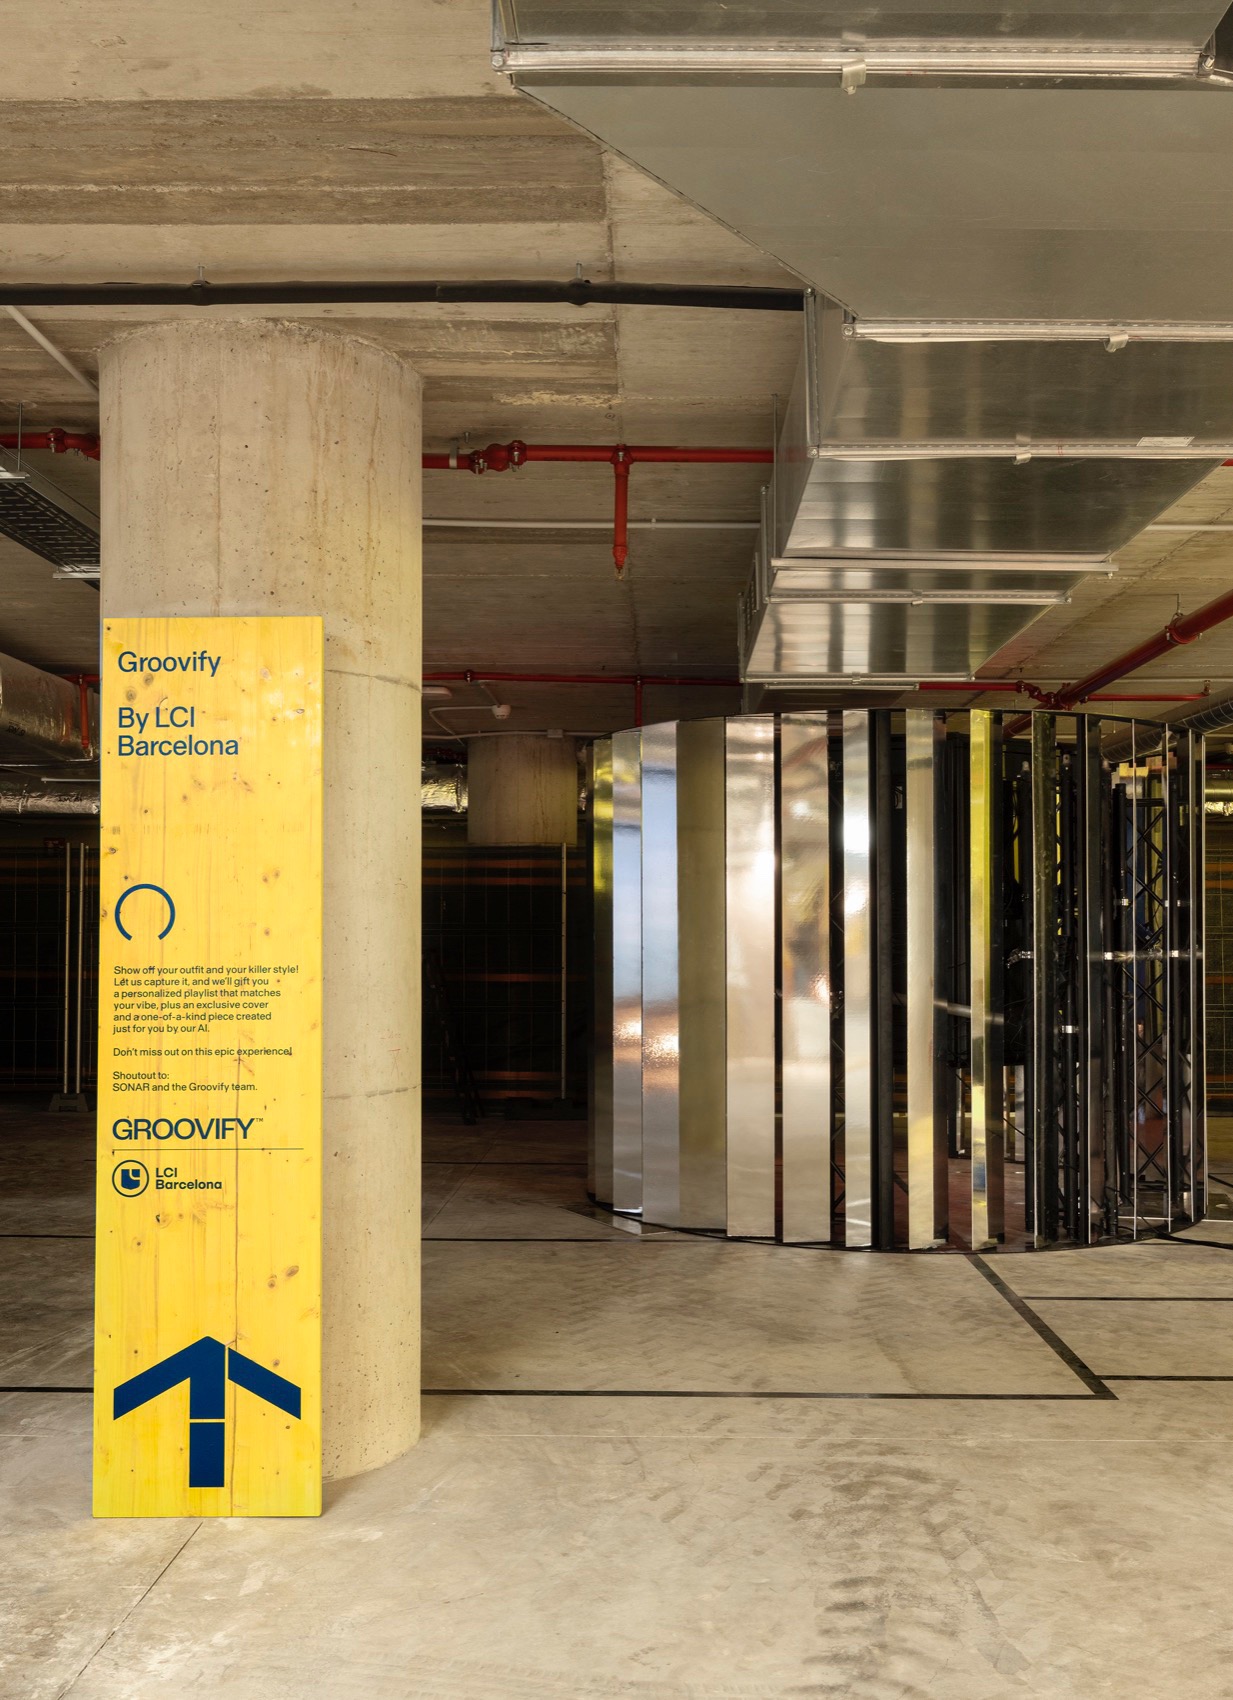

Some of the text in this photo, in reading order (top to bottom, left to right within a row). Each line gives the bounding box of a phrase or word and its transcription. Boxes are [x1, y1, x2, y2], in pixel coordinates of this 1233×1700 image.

[118, 650, 222, 677] Groovify
[118, 706, 195, 734] By LCI
[118, 734, 239, 756] Barcelona
[113, 966, 141, 974] Show
[142, 966, 156, 974] off
[157, 968, 178, 976] your
[179, 966, 205, 974] outfit
[206, 966, 224, 974] and
[248, 966, 271, 974] killer
[273, 966, 300, 974] style!
[113, 978, 130, 986] Let
[143, 979, 180, 987] capture
[182, 978, 191, 987] it,
[192, 978, 210, 986] and
[212, 978, 233, 986] we'll
[234, 977, 251, 987] gift
[252, 979, 269, 987] you
[121, 990, 182, 999] personalized
[184, 990, 219, 998] playlist
[220, 989, 239, 997] that
[113, 1003, 136, 1011] your
[136, 1002, 159, 1010] vibe,
[160, 1002, 182, 1010] plus
[113, 1014, 132, 1022] and
[140, 1013, 207, 1021] one-of-a-kind
[208, 1014, 235, 1022] piece
[236, 1013, 272, 1021] created
[112, 1025, 131, 1034] just
[132, 1025, 146, 1033] for
[147, 1027, 165, 1035] you
[166, 1025, 179, 1033] by
[197, 1024, 210, 1032] AI.
[112, 1048, 139, 1056] Don't
[195, 1048, 213, 1056] this
[214, 1050, 235, 1058] epic
[112, 1072, 170, 1080] Shoutout to:
[112, 1083, 150, 1091] SONAR
[151, 1083, 170, 1091] and
[171, 1083, 187, 1091] the
[189, 1083, 230, 1092] Groovify
[155, 1168, 178, 1178] LCI
[155, 1179, 223, 1189] Barcelona
